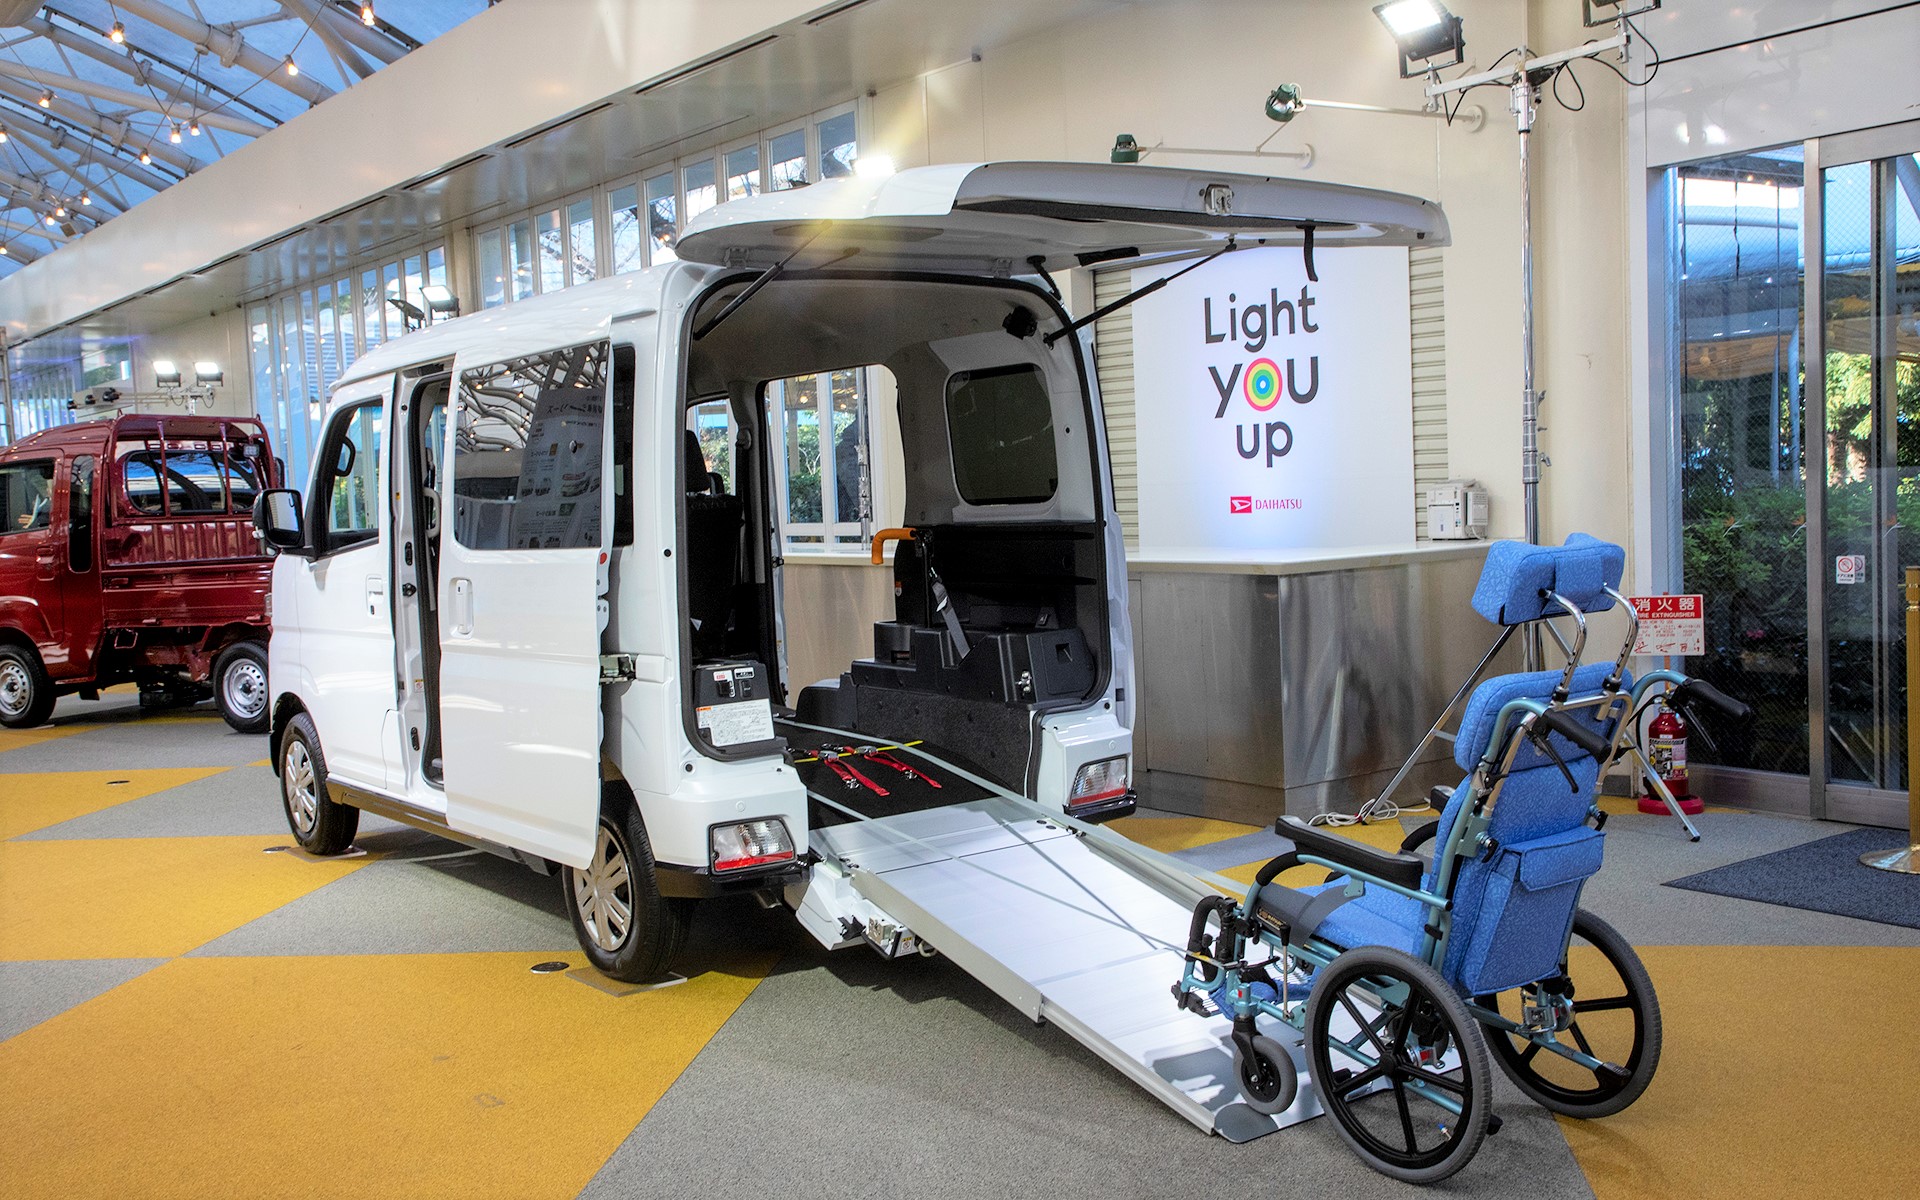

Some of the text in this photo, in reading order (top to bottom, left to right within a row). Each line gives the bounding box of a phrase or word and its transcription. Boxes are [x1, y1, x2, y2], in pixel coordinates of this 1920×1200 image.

[1204, 284, 1319, 353] Light
[1236, 421, 1293, 468] up
[1255, 498, 1303, 510] DAIHATSU
[1635, 597, 1694, 611] 消火器
